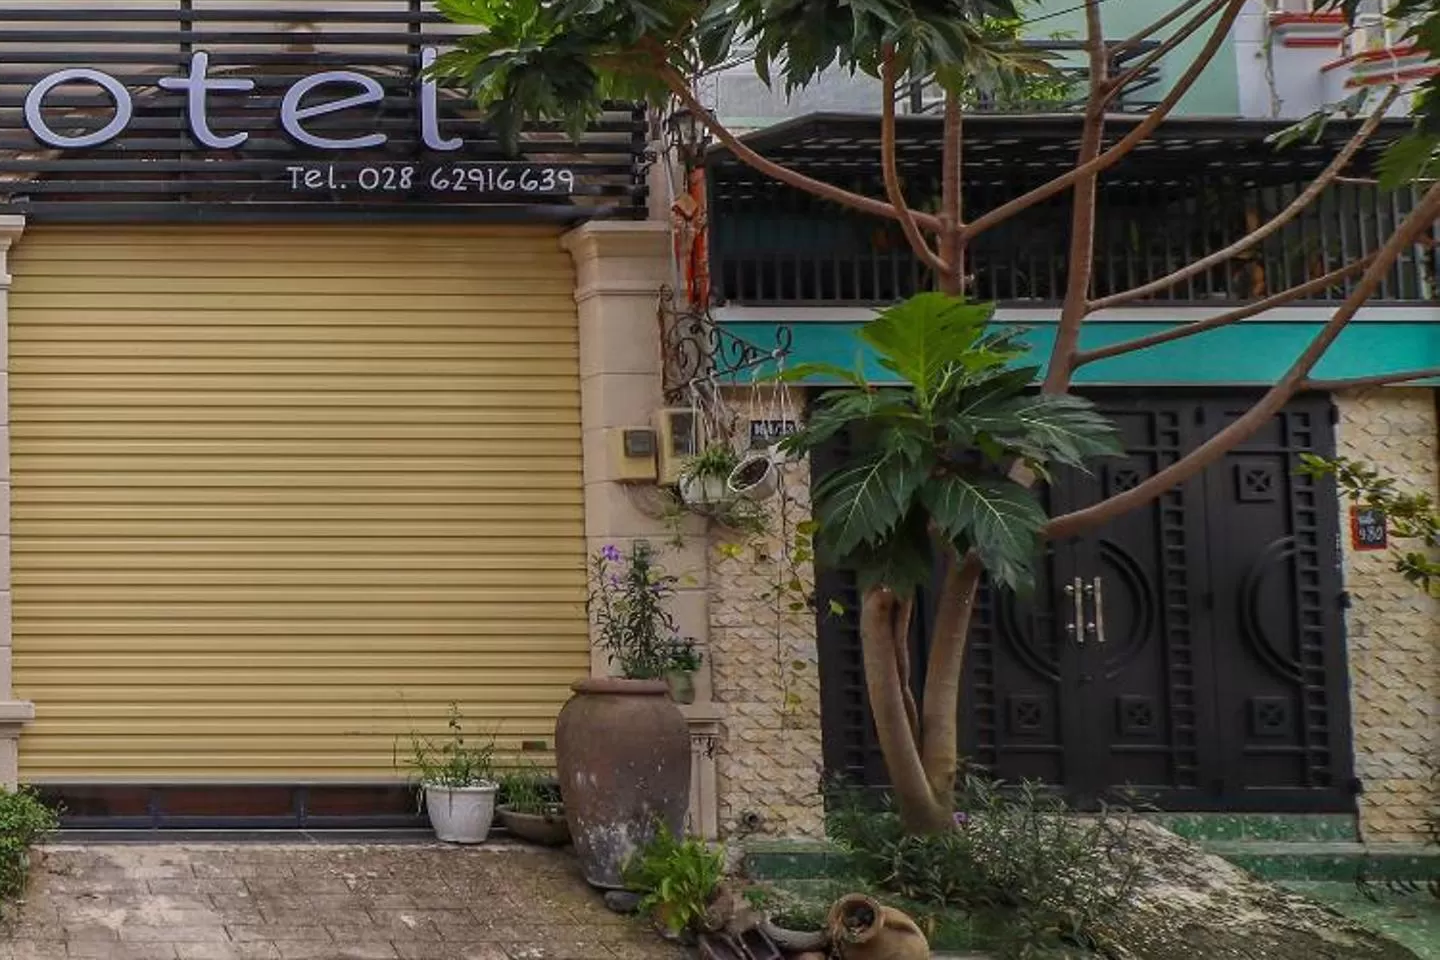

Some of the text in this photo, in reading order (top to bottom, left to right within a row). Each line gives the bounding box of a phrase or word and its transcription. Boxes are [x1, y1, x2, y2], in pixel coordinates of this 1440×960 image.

[285, 165, 575, 193] Tel. 028 62916639
